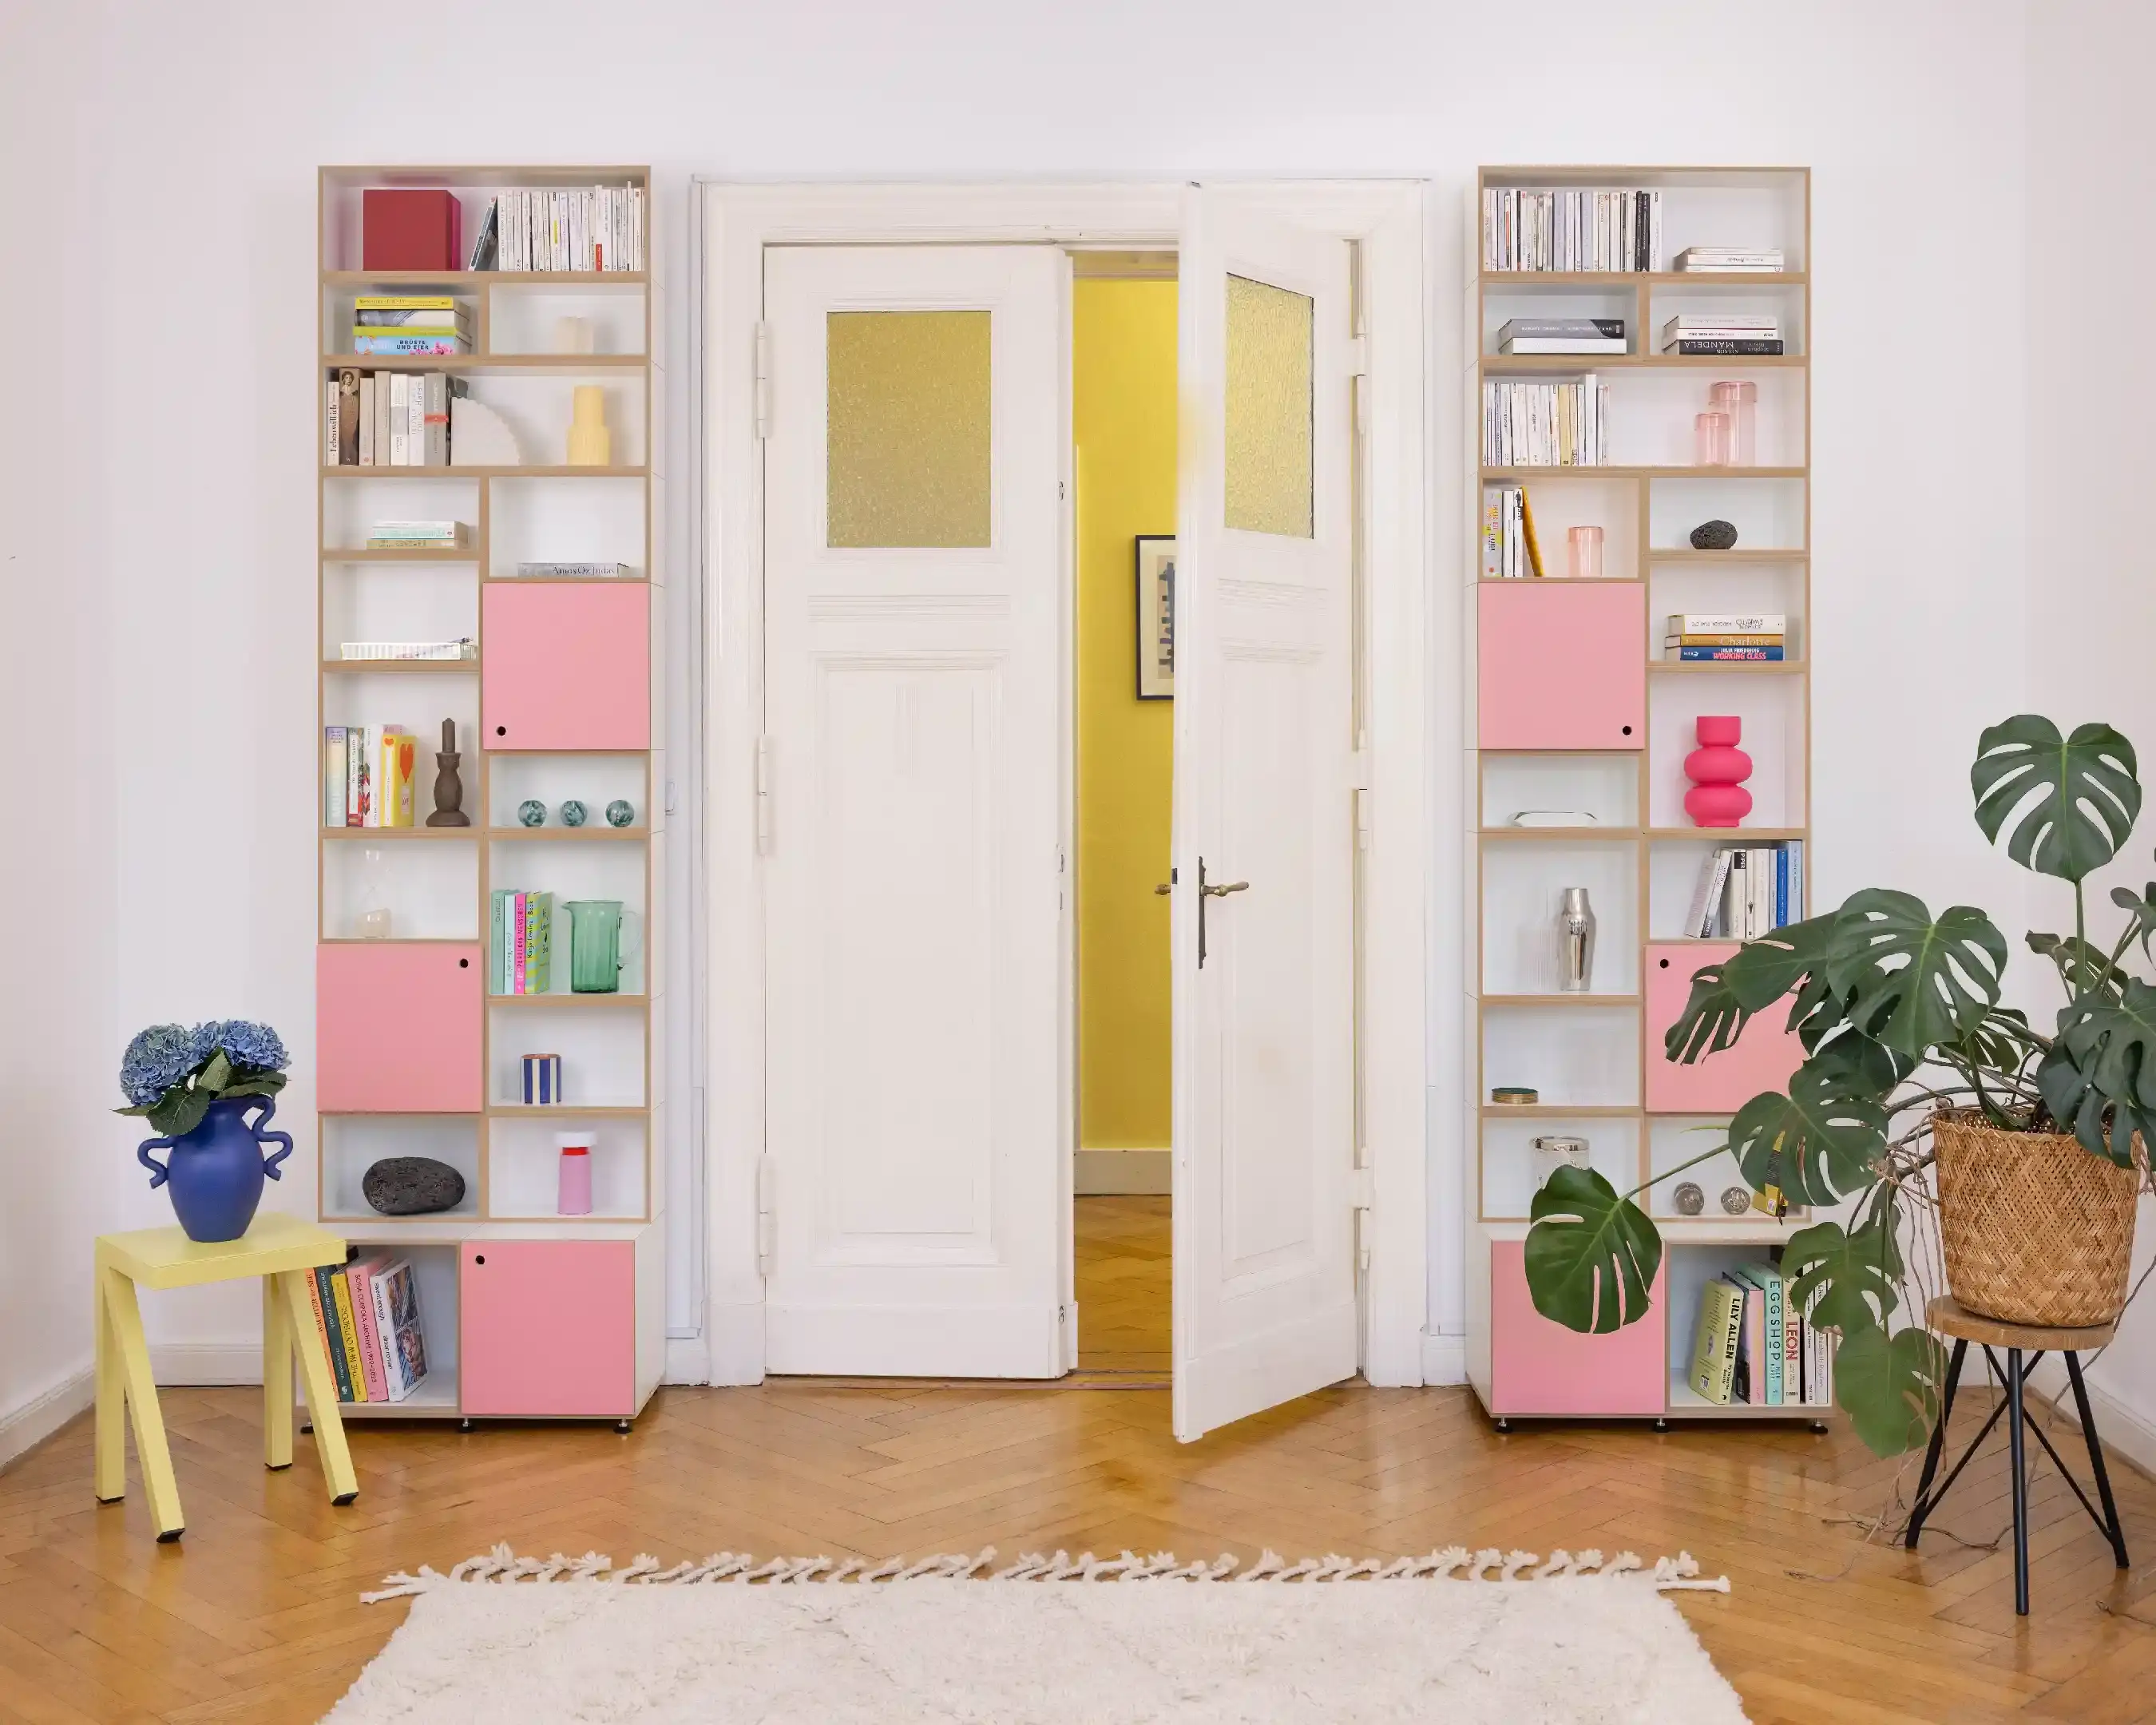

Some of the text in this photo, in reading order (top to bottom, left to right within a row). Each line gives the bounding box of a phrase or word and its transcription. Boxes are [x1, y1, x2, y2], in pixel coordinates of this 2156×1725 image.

[553, 565, 614, 576] Amos Oz Judas
[1720, 635, 1770, 646] Charlotte
[358, 1293, 368, 1322] COPPOLA
[377, 1300, 386, 1321] enough
[362, 1322, 372, 1349] ARCHIVE
[1725, 1298, 1741, 1359] LILY ALLEN
[1785, 1322, 1798, 1360] LEON
[348, 1346, 357, 1362] NEW
